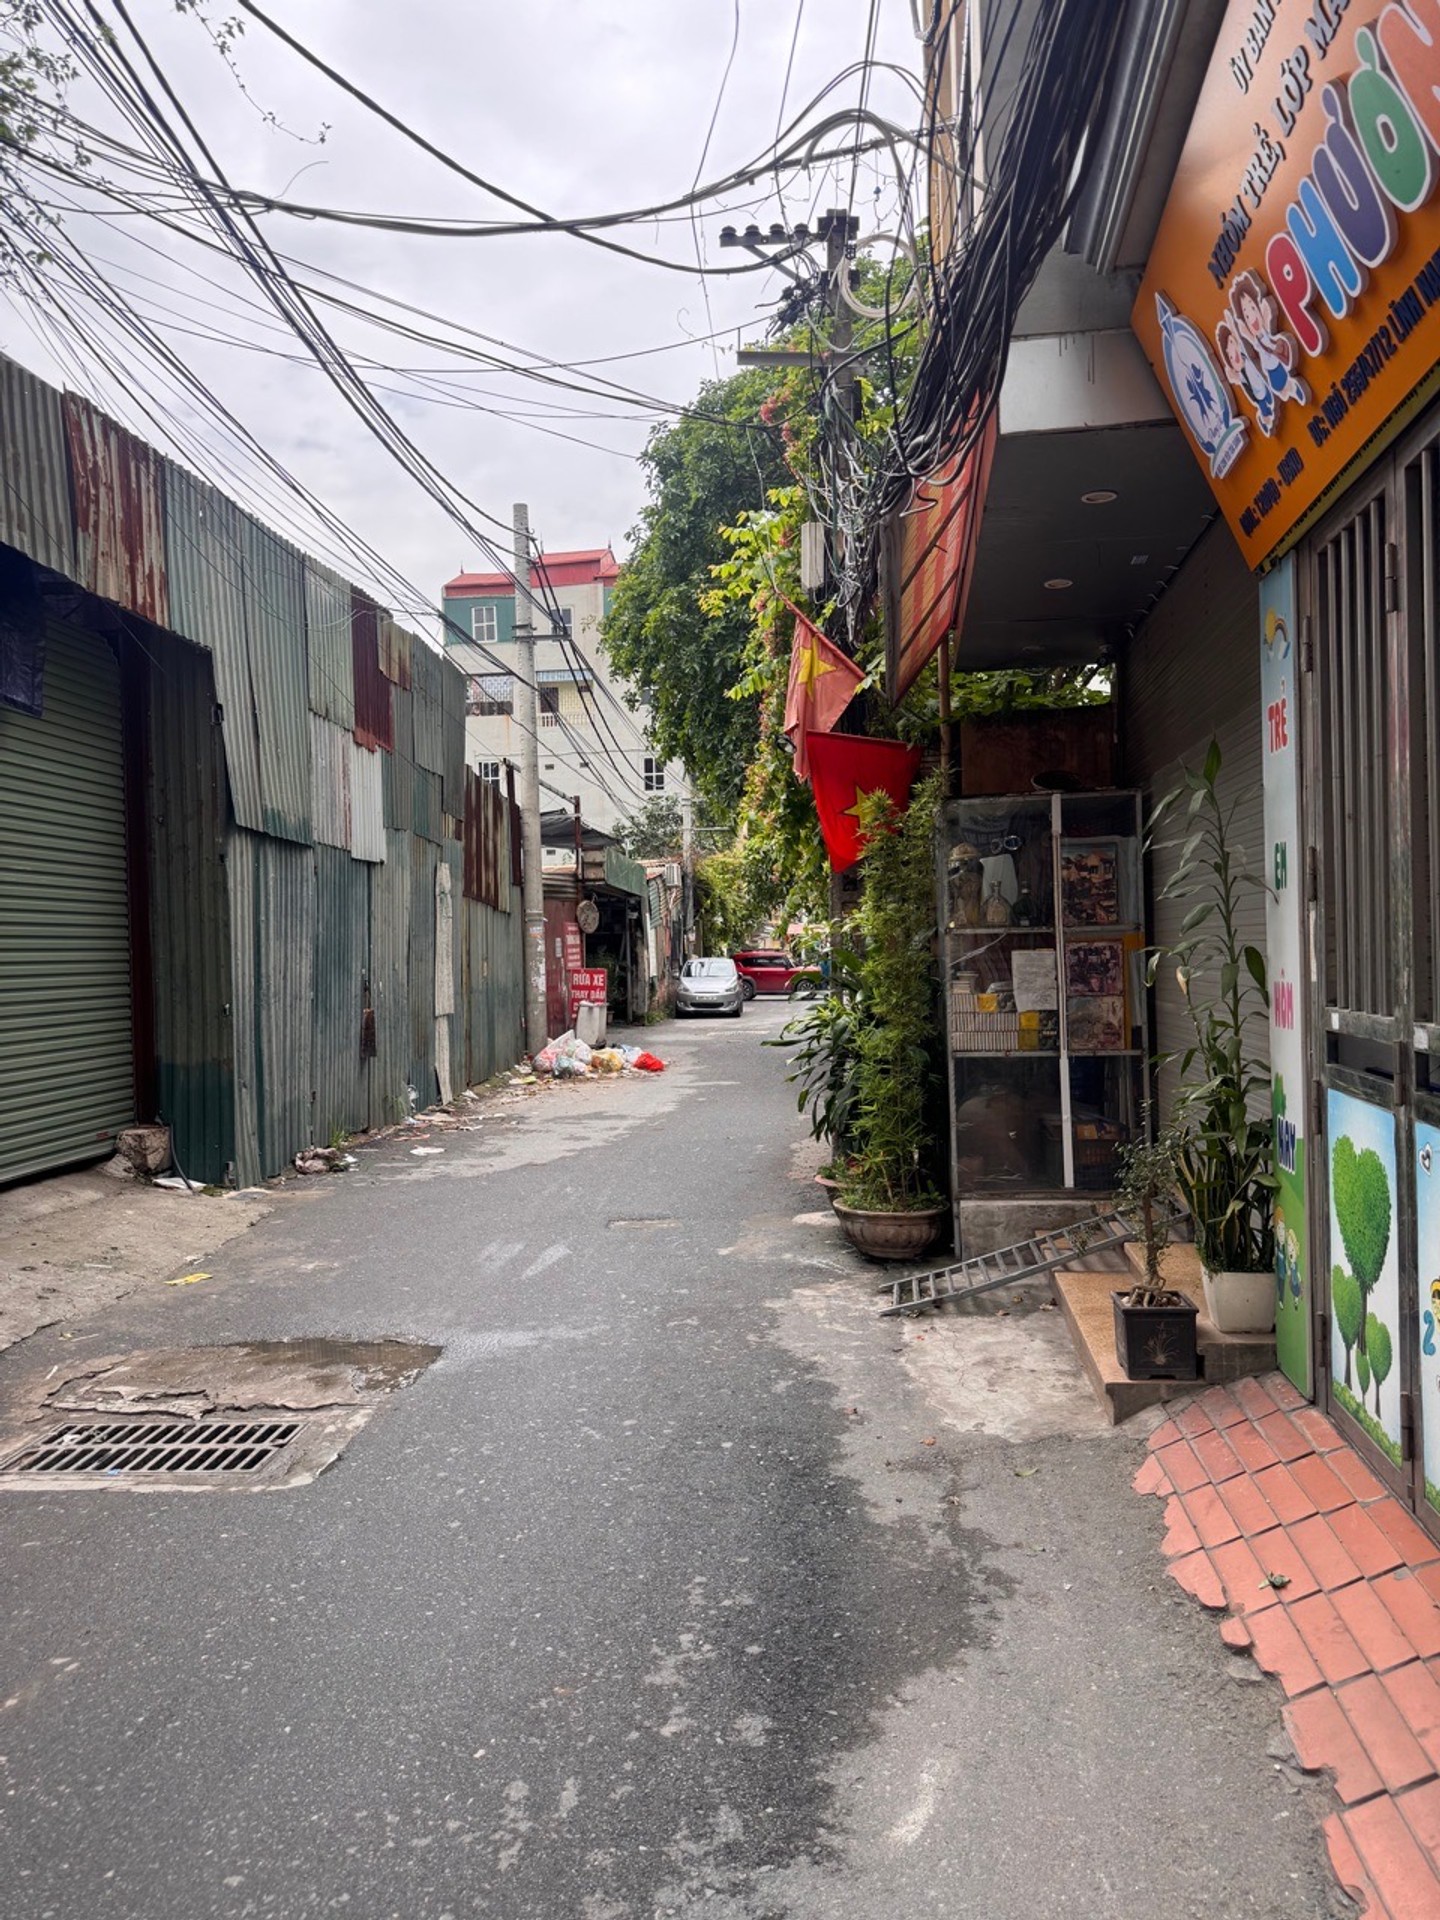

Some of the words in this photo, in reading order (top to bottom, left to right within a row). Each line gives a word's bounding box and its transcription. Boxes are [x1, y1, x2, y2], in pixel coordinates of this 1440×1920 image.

[1208, 194, 1252, 289] NHÓM
[1274, 841, 1287, 890] EM
[592, 973, 604, 987] XE
